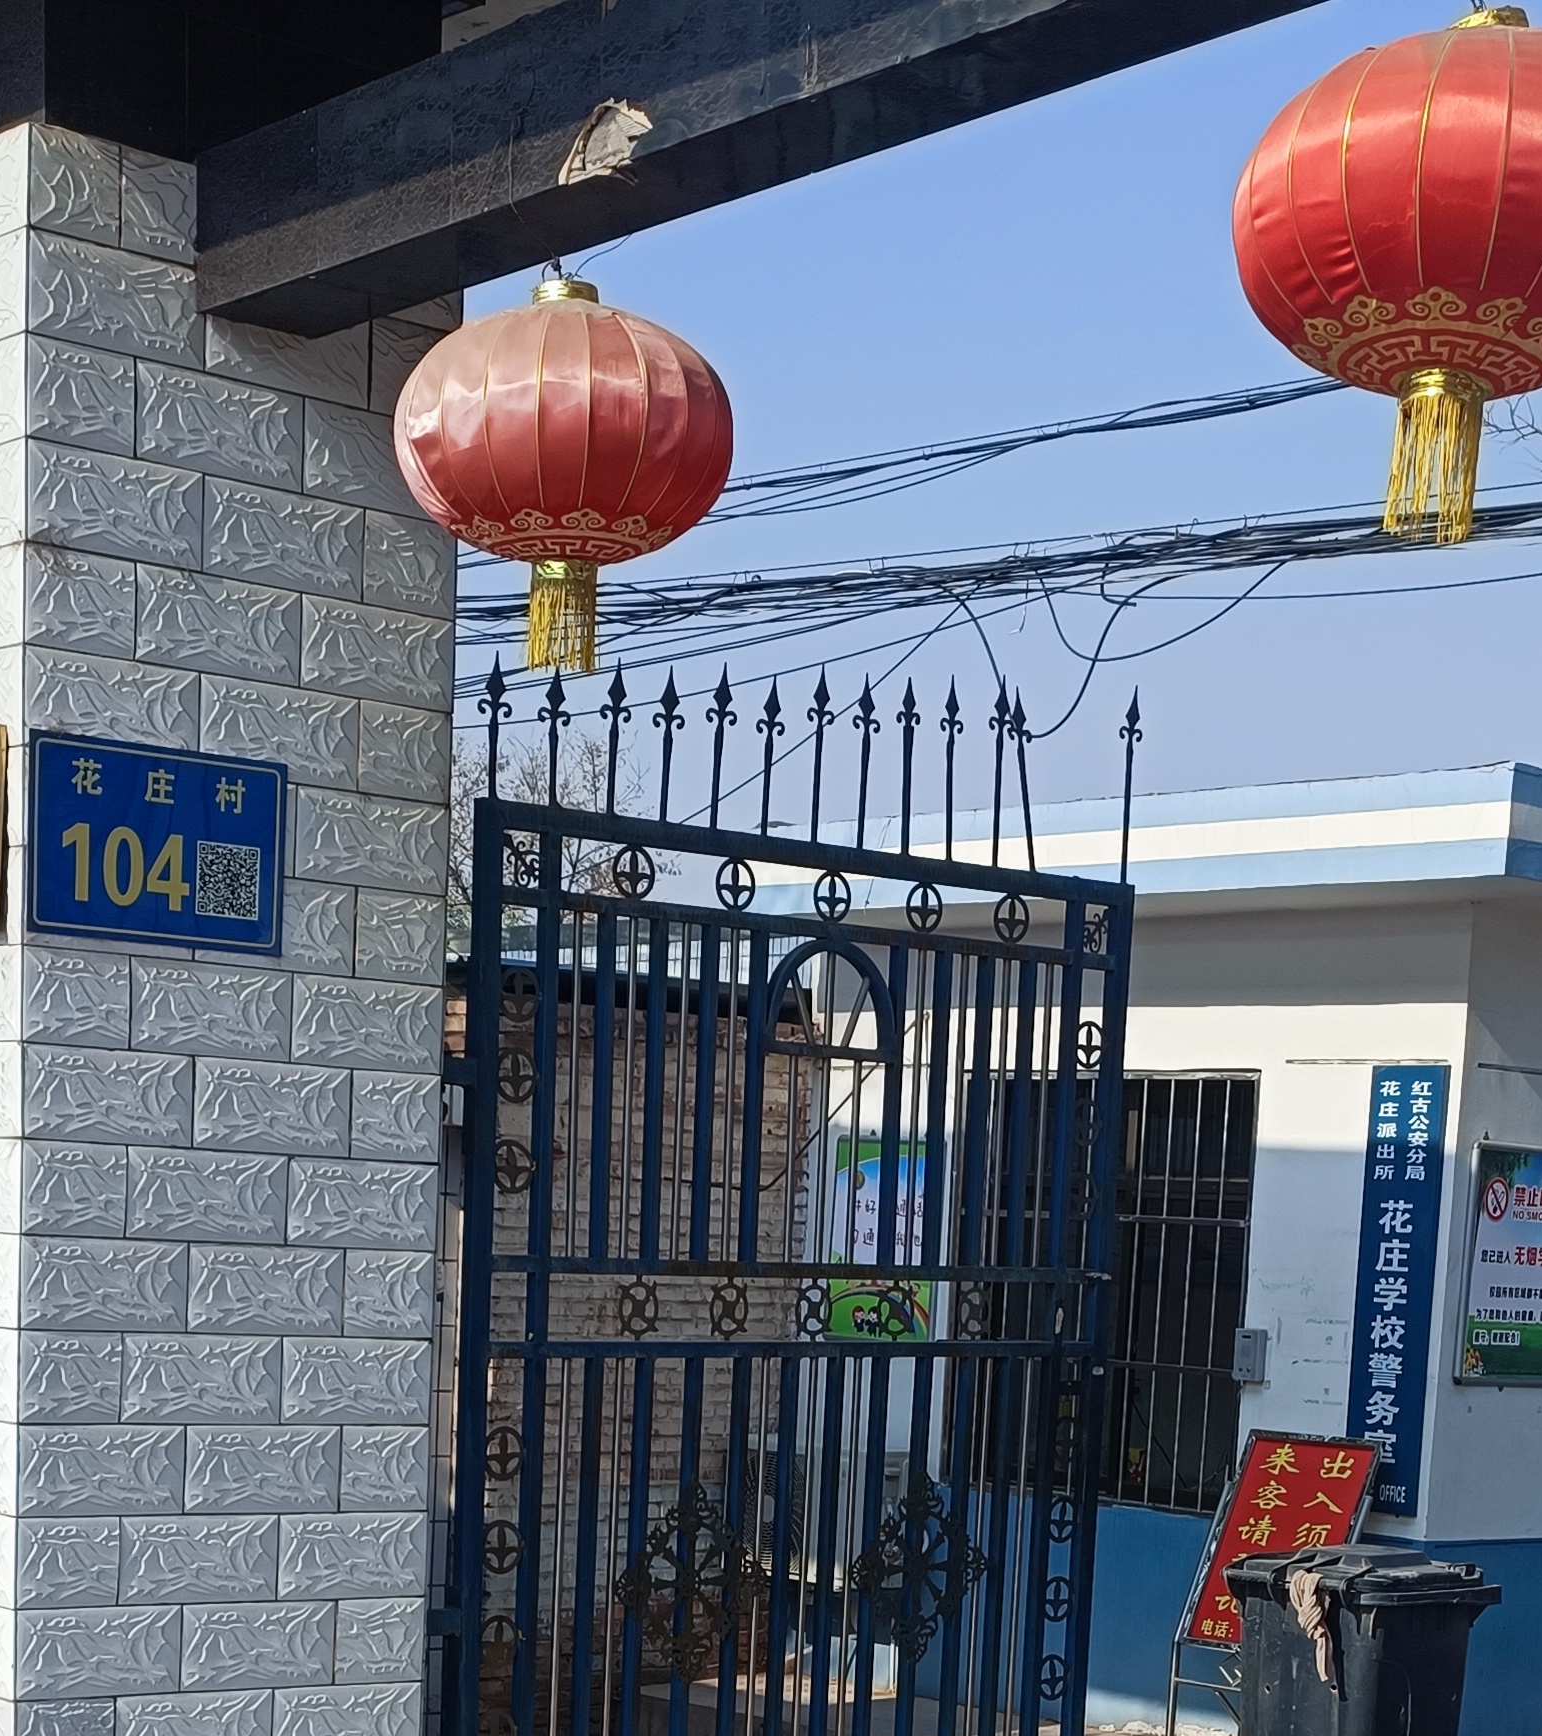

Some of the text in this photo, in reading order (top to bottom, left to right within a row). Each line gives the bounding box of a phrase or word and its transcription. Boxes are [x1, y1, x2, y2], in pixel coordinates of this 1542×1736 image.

[70, 757, 246, 815] 花庄村
[61, 822, 191, 912] 104
[1373, 1080, 1402, 1180] 花庄派出所
[1404, 1080, 1433, 1181] 红古公安分局
[1512, 1210, 1525, 1220] NO
[1363, 1199, 1414, 1465] 花庄学校警务室
[1379, 1484, 1406, 1504] OFFICE
